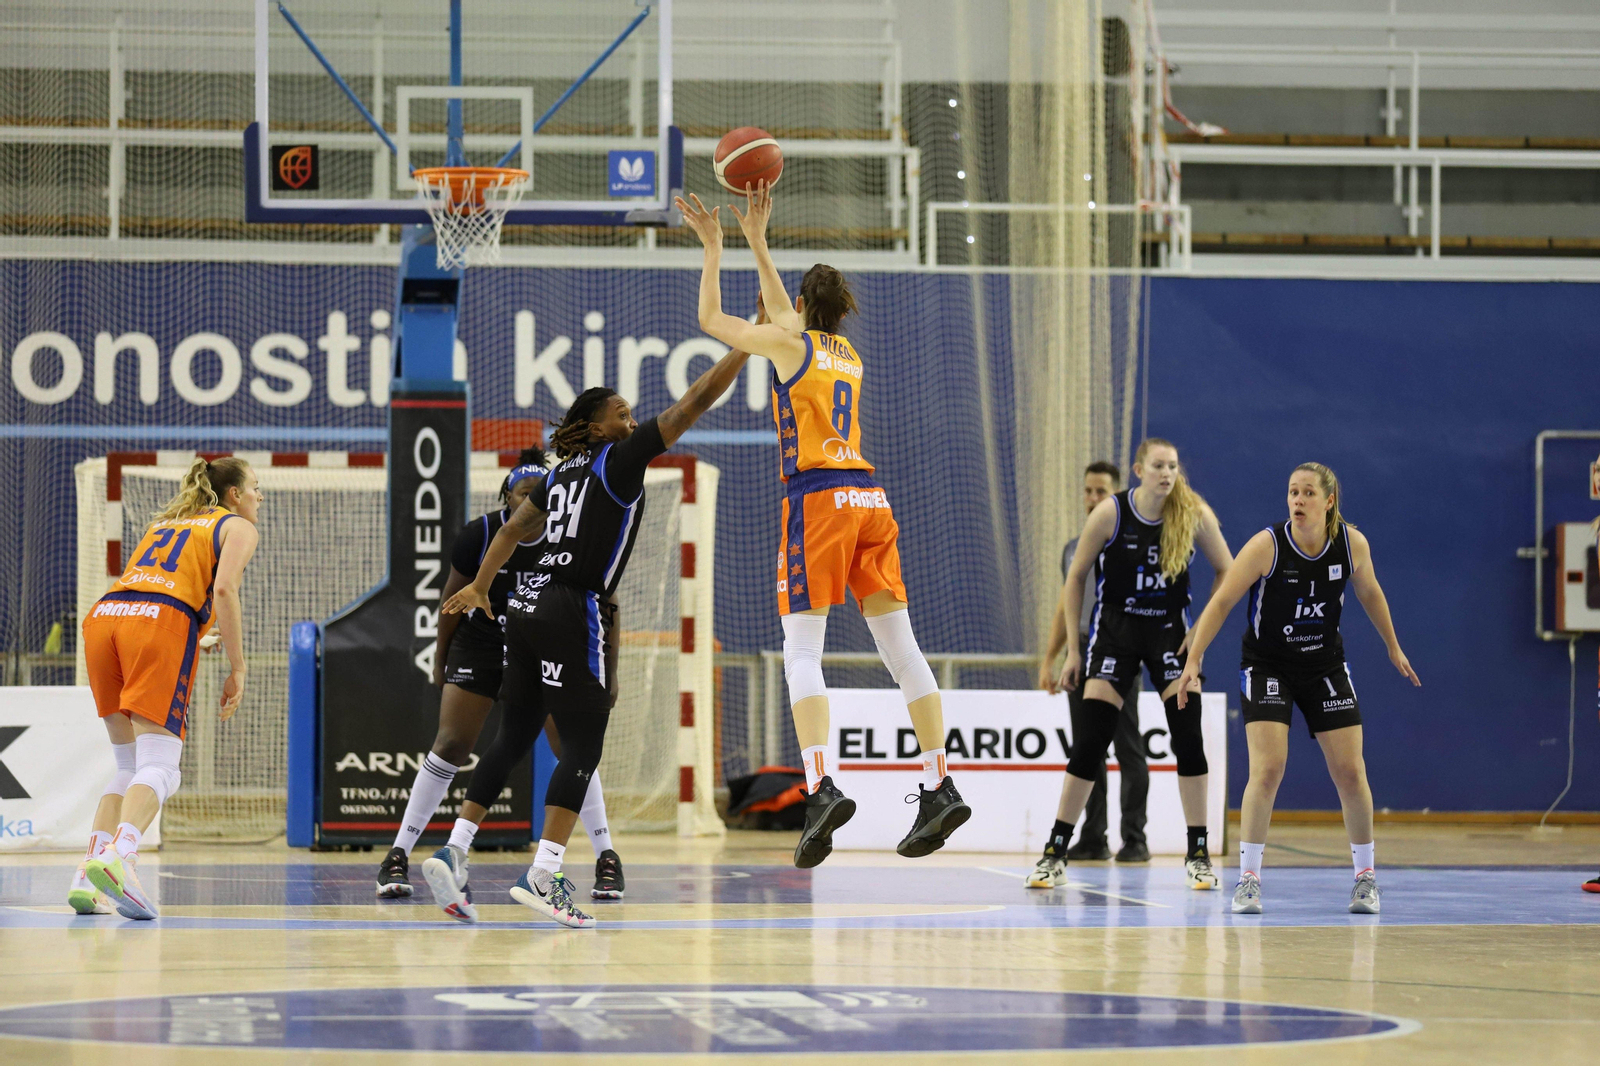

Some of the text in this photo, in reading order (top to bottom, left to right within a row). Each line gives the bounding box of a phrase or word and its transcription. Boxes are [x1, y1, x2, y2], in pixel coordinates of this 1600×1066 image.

[11, 309, 467, 407] onosti
[819, 334, 855, 361] ALLEN
[832, 379, 852, 441] 8
[546, 477, 590, 543] 24
[135, 528, 192, 573] 21
[414, 426, 442, 684] ARNEDO
[1147, 545, 1159, 565] 5
[1309, 580, 1315, 597] 1
[92, 602, 160, 619] PAMESA
[541, 659, 564, 680] DV
[1323, 677, 1338, 697] 1
[838, 728, 887, 759] EL
[896, 728, 1046, 760] DARIO
